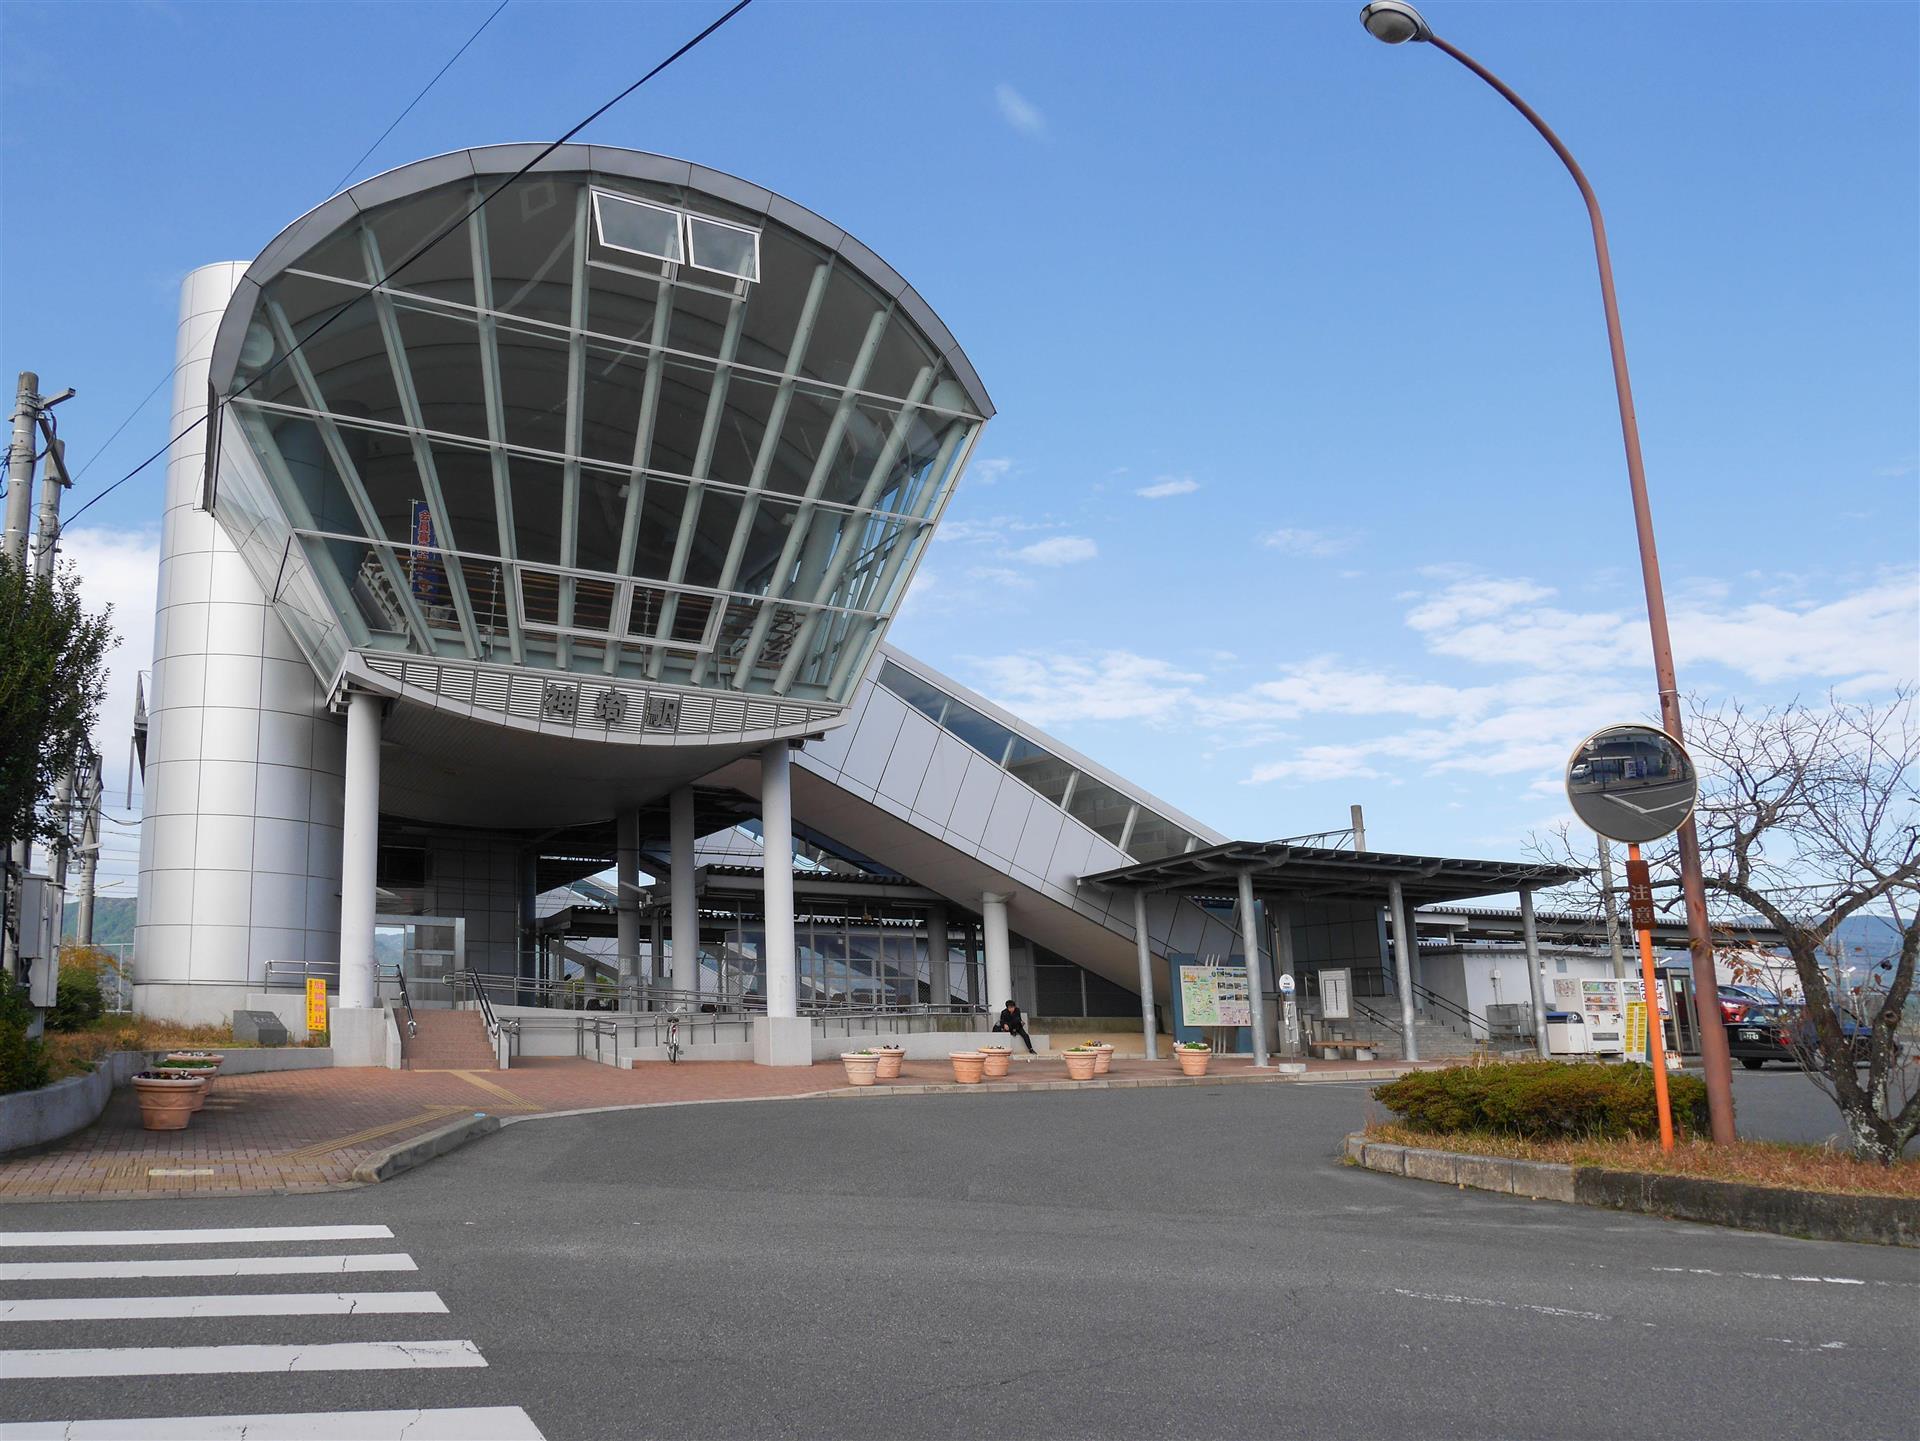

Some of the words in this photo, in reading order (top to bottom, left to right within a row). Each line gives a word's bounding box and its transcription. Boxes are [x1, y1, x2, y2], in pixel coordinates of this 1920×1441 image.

[545, 685, 682, 728] 神埼駅
[1631, 884, 1652, 924] 注意
